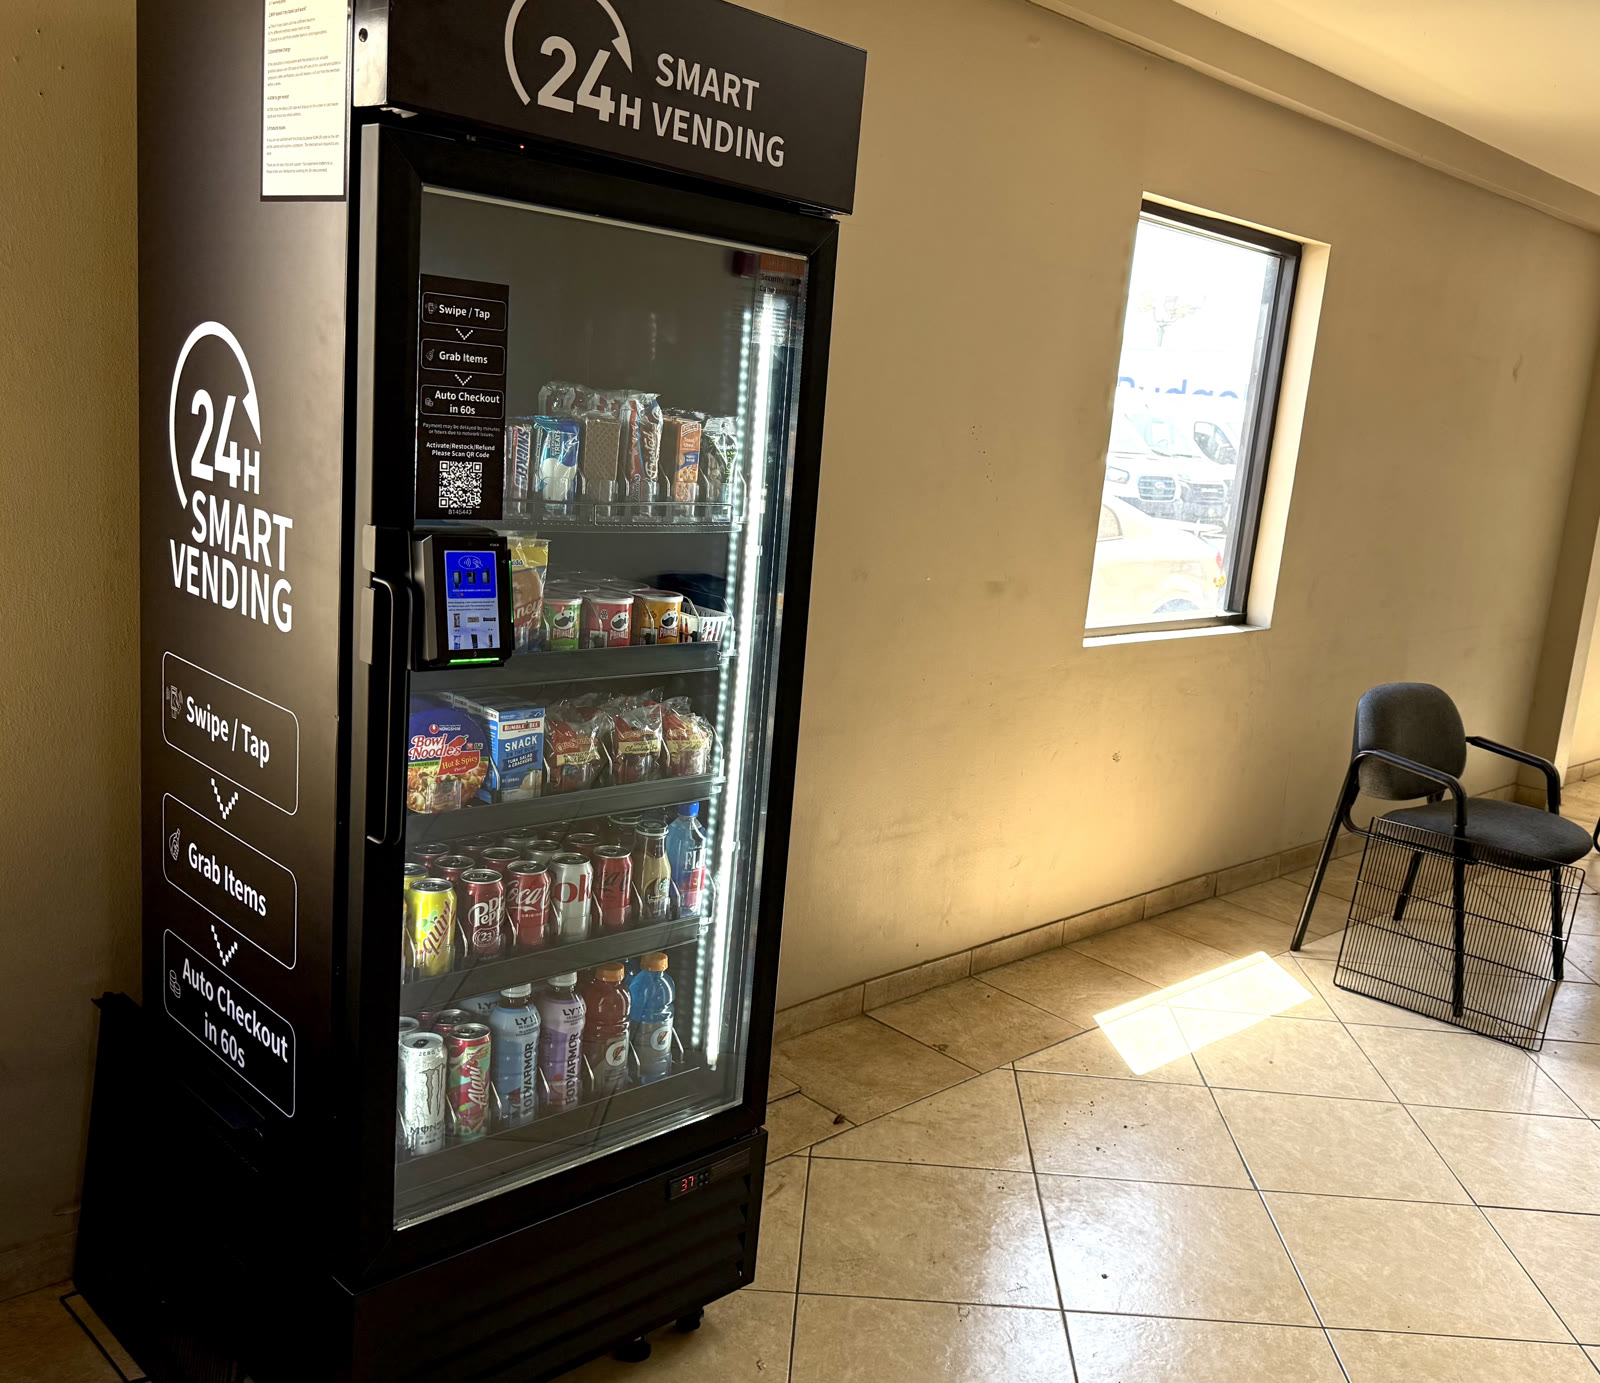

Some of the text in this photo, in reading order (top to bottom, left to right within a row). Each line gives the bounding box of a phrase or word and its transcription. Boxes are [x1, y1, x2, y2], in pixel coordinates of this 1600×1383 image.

[537, 35, 642, 131] 24H
[655, 53, 760, 111] SMART
[652, 101, 785, 168] VENDING
[438, 304, 467, 319] Swipe
[474, 308, 491, 320] Tap
[439, 351, 488, 364] Grab Items
[434, 390, 500, 404] Auto Checkout
[449, 403, 476, 415] in 60s
[422, 422, 442, 430] Payment
[190, 388, 260, 495] 24H
[426, 442, 495, 451] Activate/Restock/Refund
[431, 449, 451, 457] Please
[191, 489, 293, 572] SMART
[169, 538, 292, 633] VENDING
[186, 695, 229, 742] Swipe
[241, 723, 270, 769] Tap
[504, 723, 525, 732] BUMBLE
[410, 733, 449, 748] Bowl
[504, 735, 538, 752] SNACK
[408, 744, 462, 760] Noodles
[442, 760, 454, 770] Hot
[461, 755, 478, 765] Spicy
[188, 841, 267, 917] Grab Items
[481, 931, 492, 942] 23
[182, 957, 289, 1064] Auto Checkout
[203, 1011, 246, 1069] in 60s
[565, 1032, 579, 1104] BODYARMOR
[467, 1064, 488, 1108] Alani
[522, 1041, 535, 1117] BODYARMOR
[681, 1175, 695, 1192] 37
